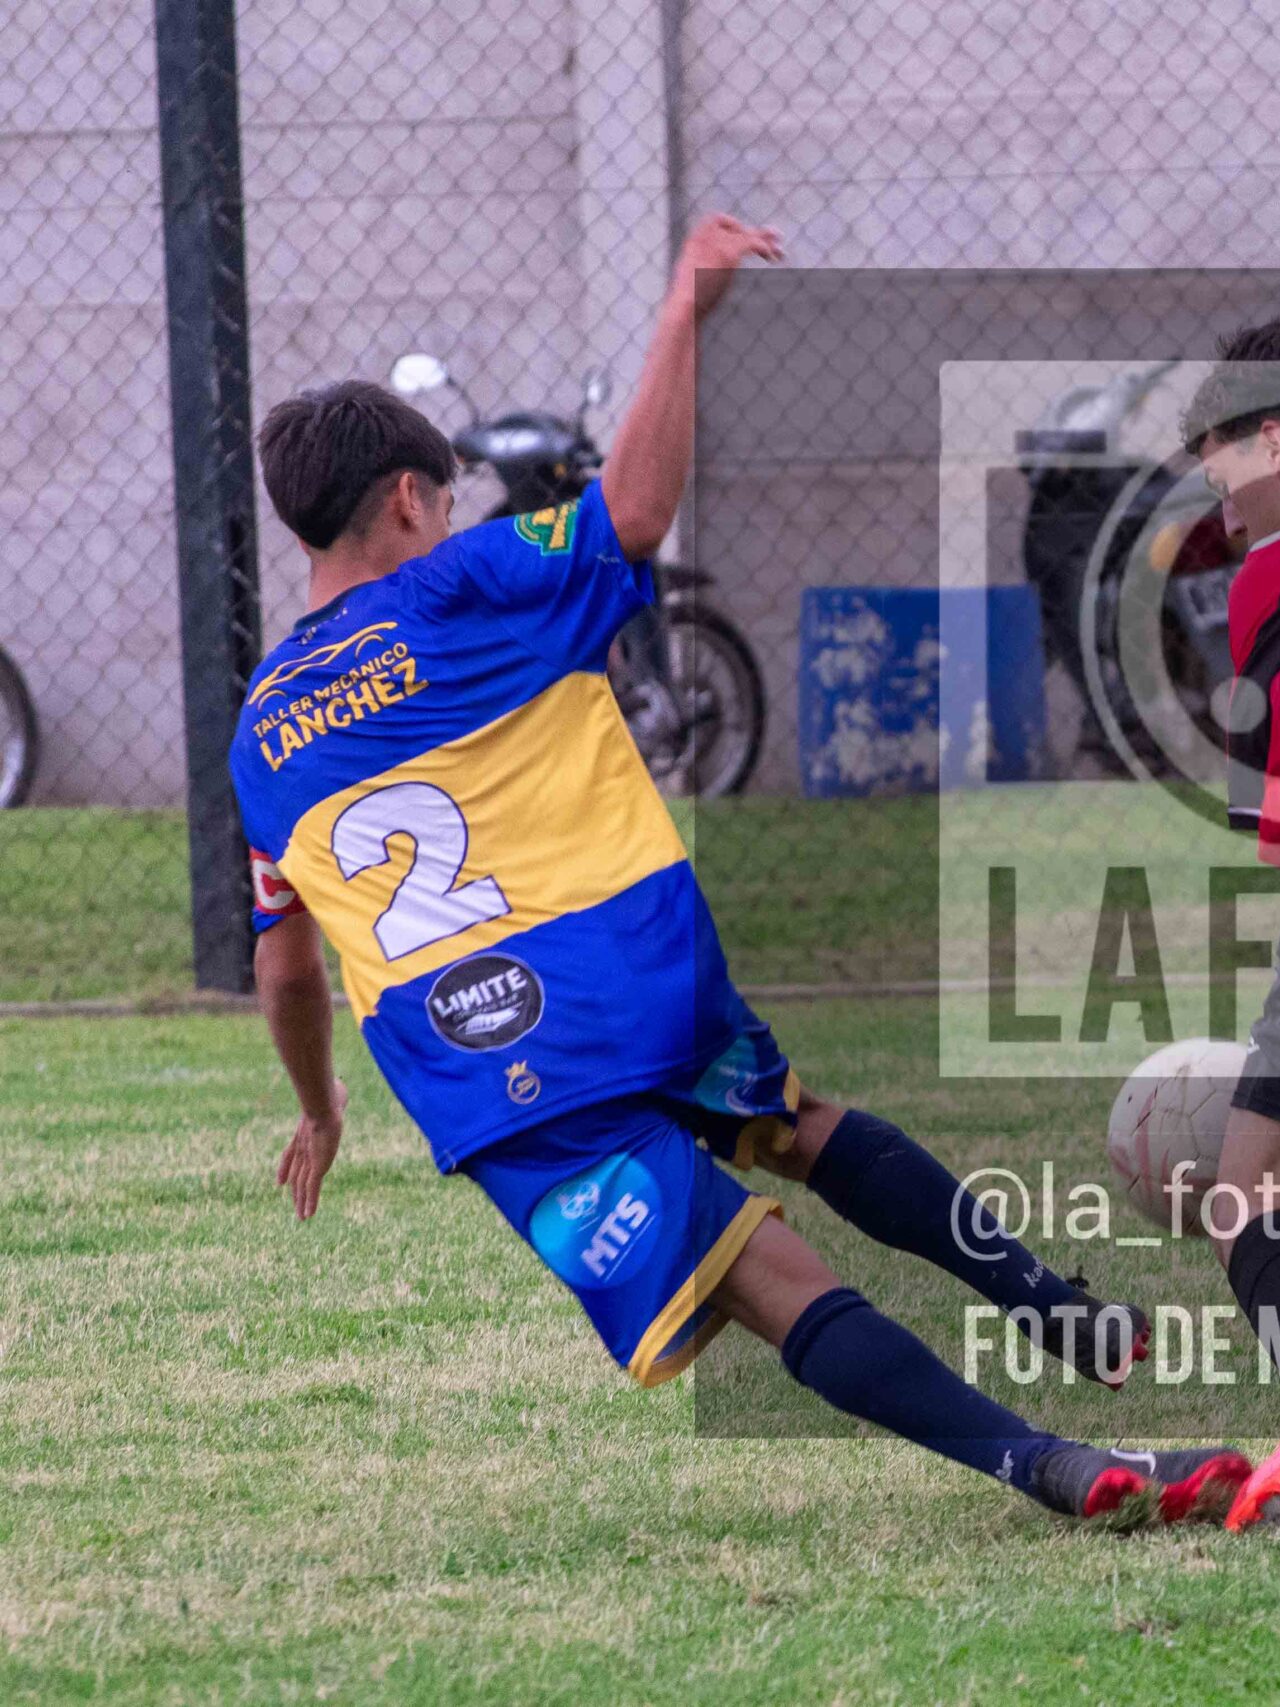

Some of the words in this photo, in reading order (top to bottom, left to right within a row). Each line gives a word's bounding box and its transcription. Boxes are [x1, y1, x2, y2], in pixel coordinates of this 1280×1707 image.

[252, 695, 314, 738] TALLER
[259, 657, 430, 772] LANCHEZ
[252, 858, 296, 909] C
[331, 780, 513, 963] 2
[432, 966, 528, 1018] LIMITE
[580, 1192, 650, 1278] MTS
